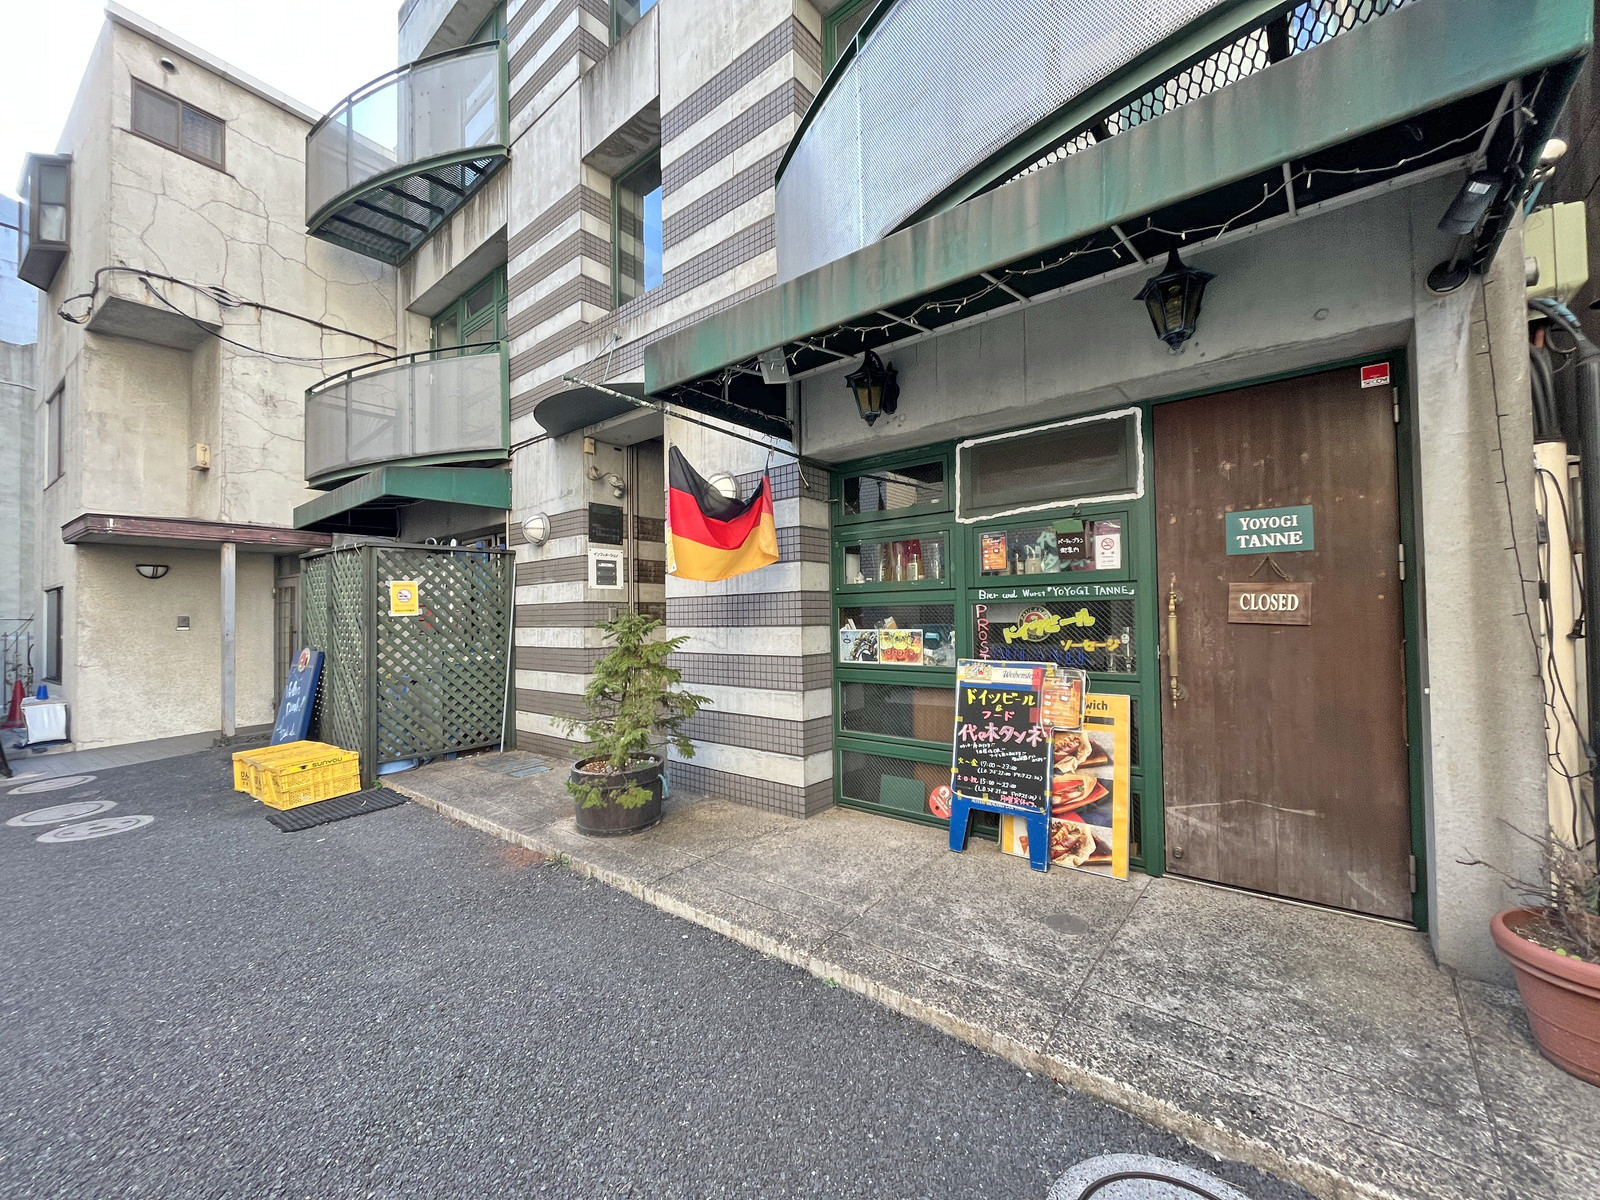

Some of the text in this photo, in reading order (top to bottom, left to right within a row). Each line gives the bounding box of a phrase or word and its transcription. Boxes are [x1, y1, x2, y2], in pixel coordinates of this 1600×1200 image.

[1239, 515, 1298, 531] YOYOGI
[1237, 531, 1303, 549] TANNE
[978, 589, 999, 600] Bier
[1002, 590, 1018, 599] und
[1022, 589, 1046, 597] Wurst
[1239, 593, 1299, 611] CLOSED
[1060, 638, 1121, 652] ソーセージ
[967, 688, 1036, 706] ドイツビール
[982, 710, 1015, 722] フード
